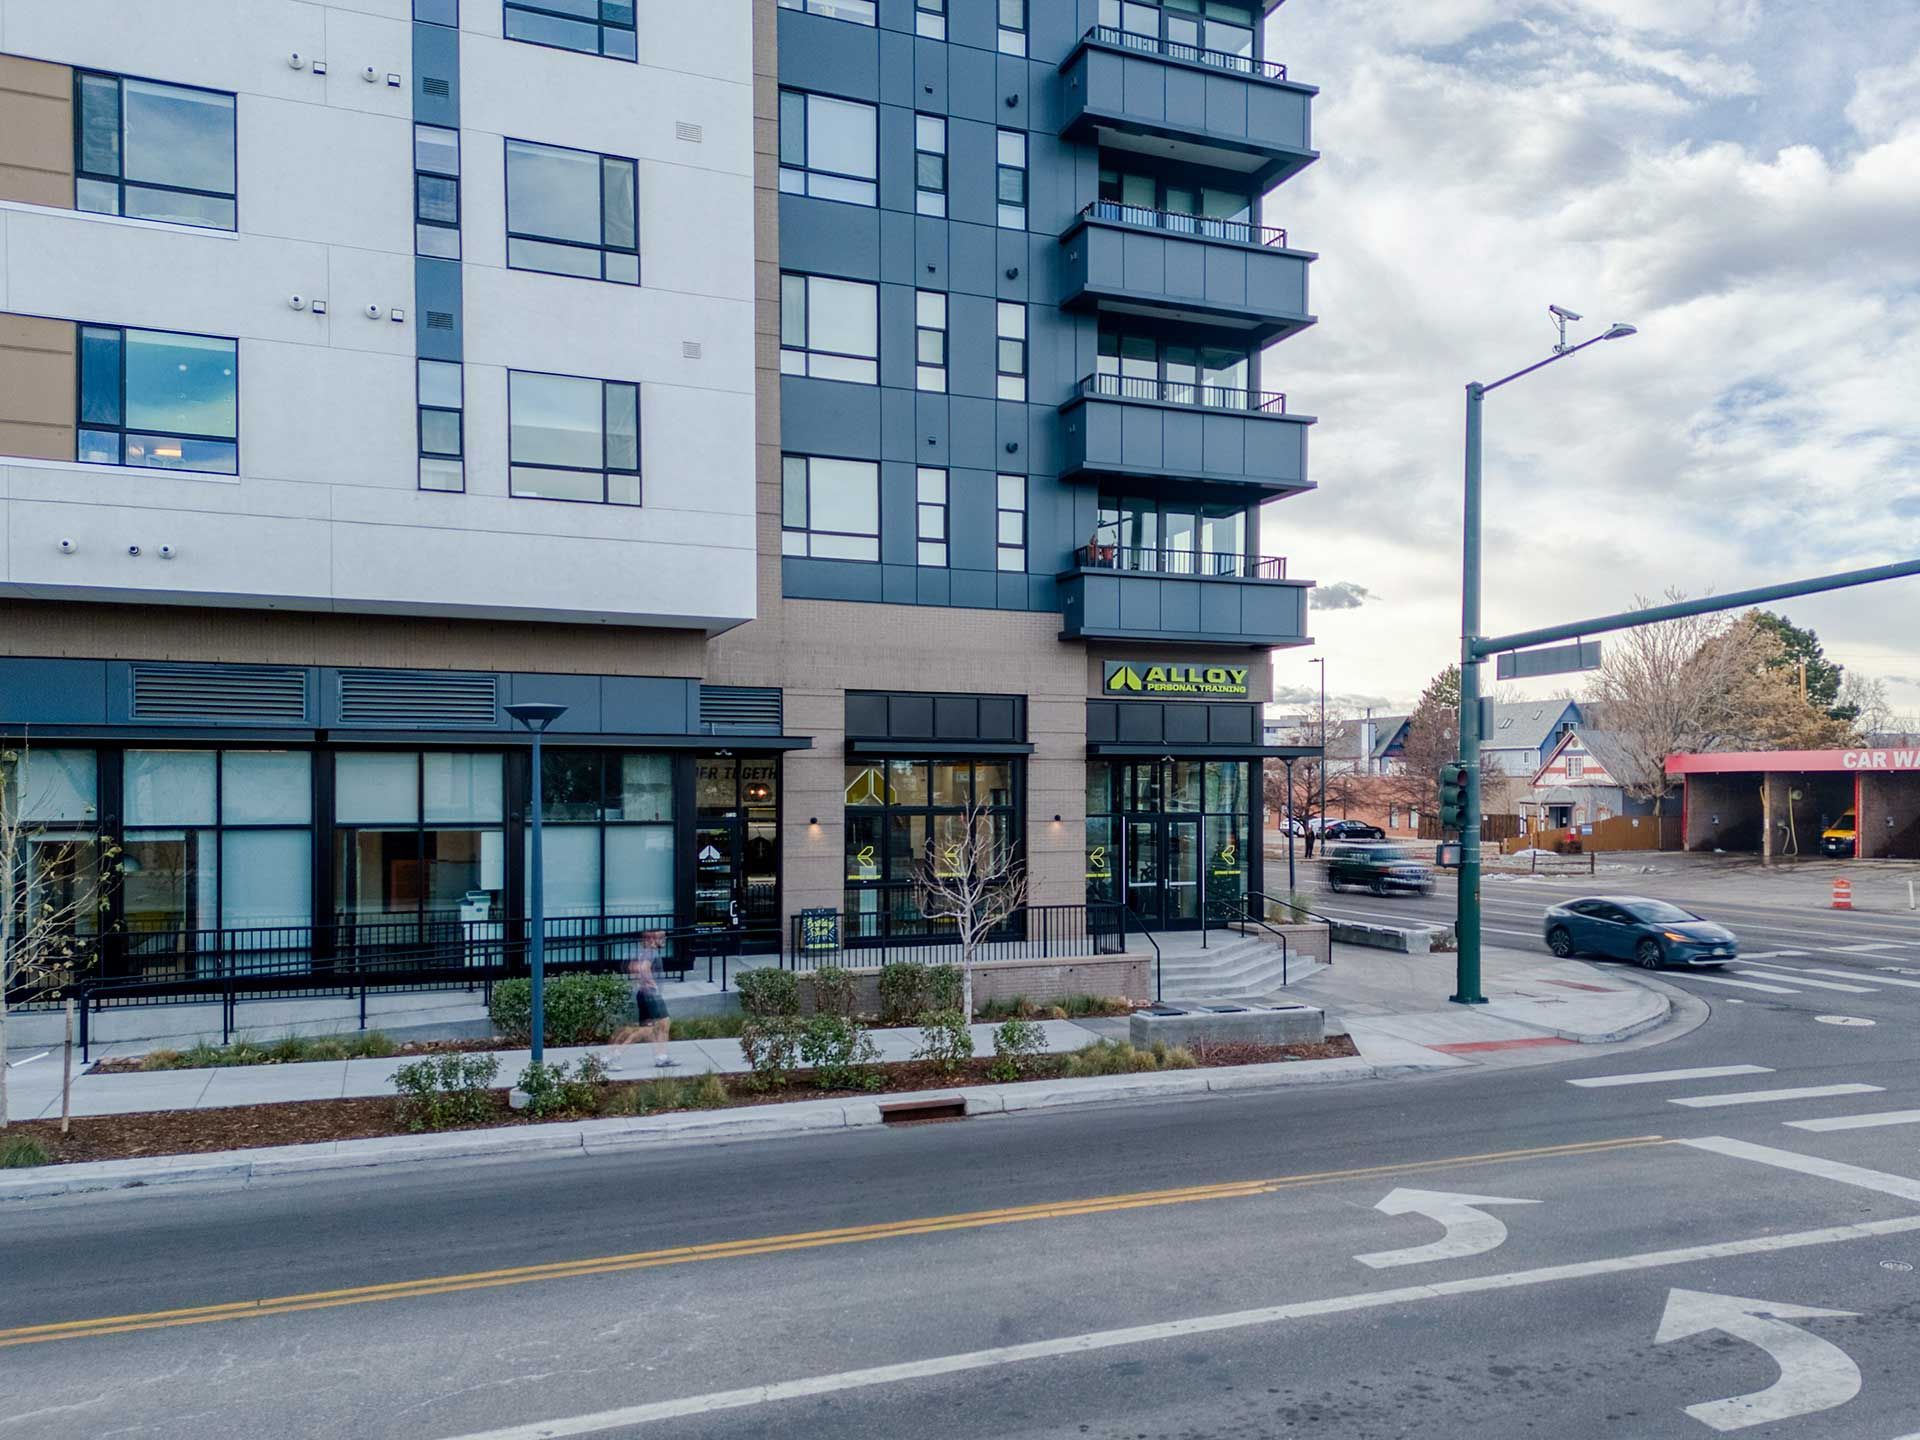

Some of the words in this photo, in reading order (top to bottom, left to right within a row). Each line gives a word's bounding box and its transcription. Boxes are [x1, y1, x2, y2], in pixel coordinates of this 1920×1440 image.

[1146, 667, 1247, 684] ALLOY
[1148, 683, 1198, 693] PERSONAL
[1199, 684, 1246, 693] TRAINING
[1843, 751, 1887, 769] CAR
[697, 767, 718, 779] ER
[724, 766, 776, 779] TGETH
